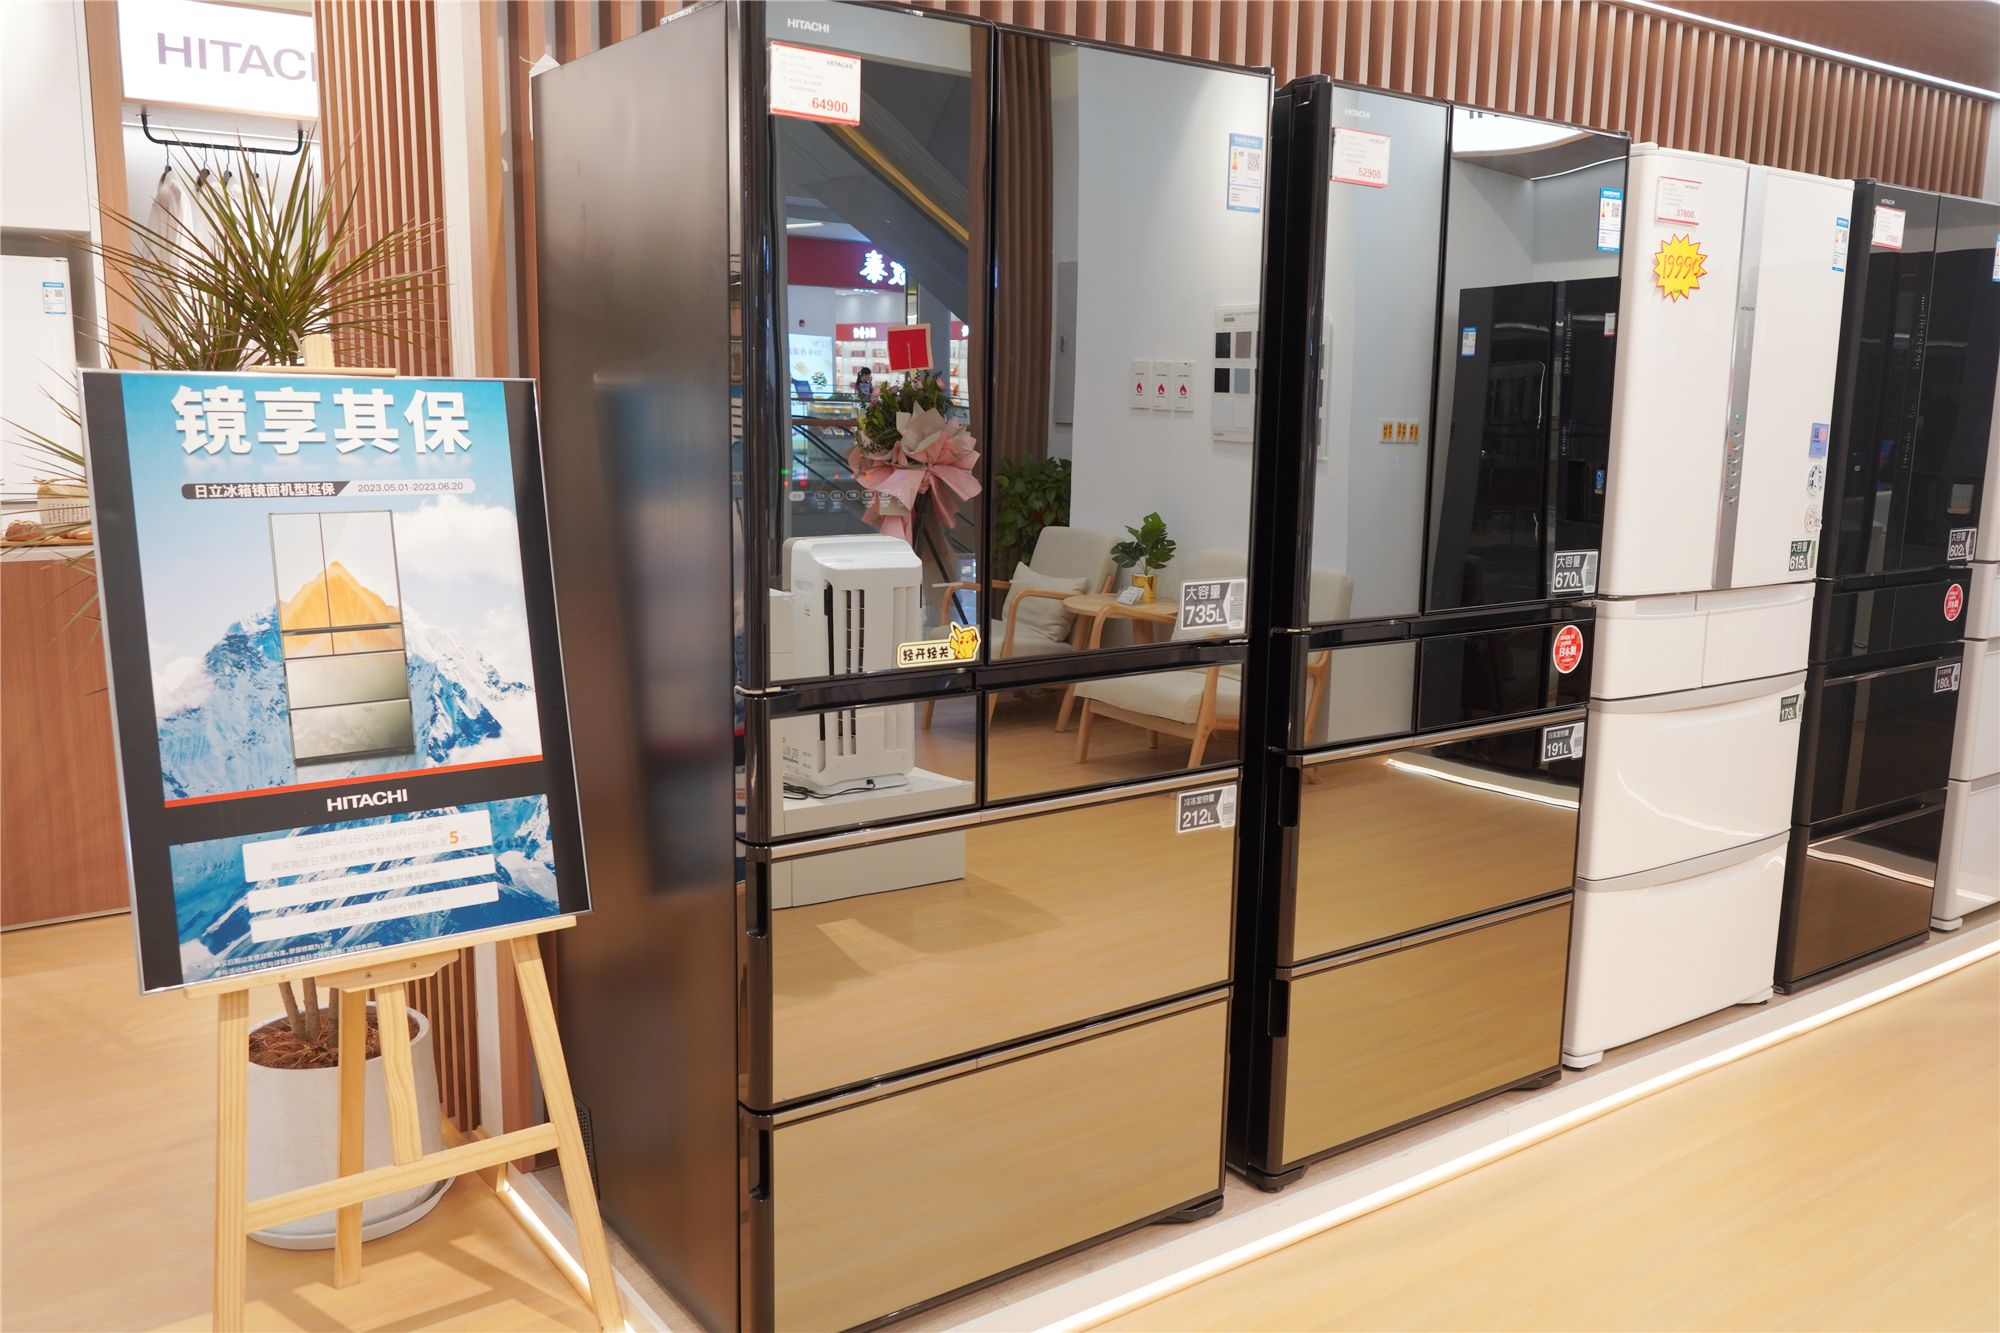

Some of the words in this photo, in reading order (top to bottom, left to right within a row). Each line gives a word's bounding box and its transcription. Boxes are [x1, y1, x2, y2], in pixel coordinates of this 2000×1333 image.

[787, 18, 830, 33] HITACHI
[1344, 107, 1371, 119] HITACHI
[171, 385, 472, 455] 镜享其保
[194, 483, 336, 499] 日立冰箱镜面机型延保
[357, 482, 464, 493] 2023.05.01-2023.06.20
[1557, 555, 1581, 568] 大容量
[1555, 571, 1582, 588] 670L
[1185, 584, 1221, 601] 大容量
[1185, 603, 1224, 625] 735L
[903, 645, 949, 662] 轻开轻关
[1546, 741, 1569, 757] 191L
[326, 788, 408, 812] HITACHI
[1182, 808, 1215, 829] 212L
[449, 830, 460, 844] 5
